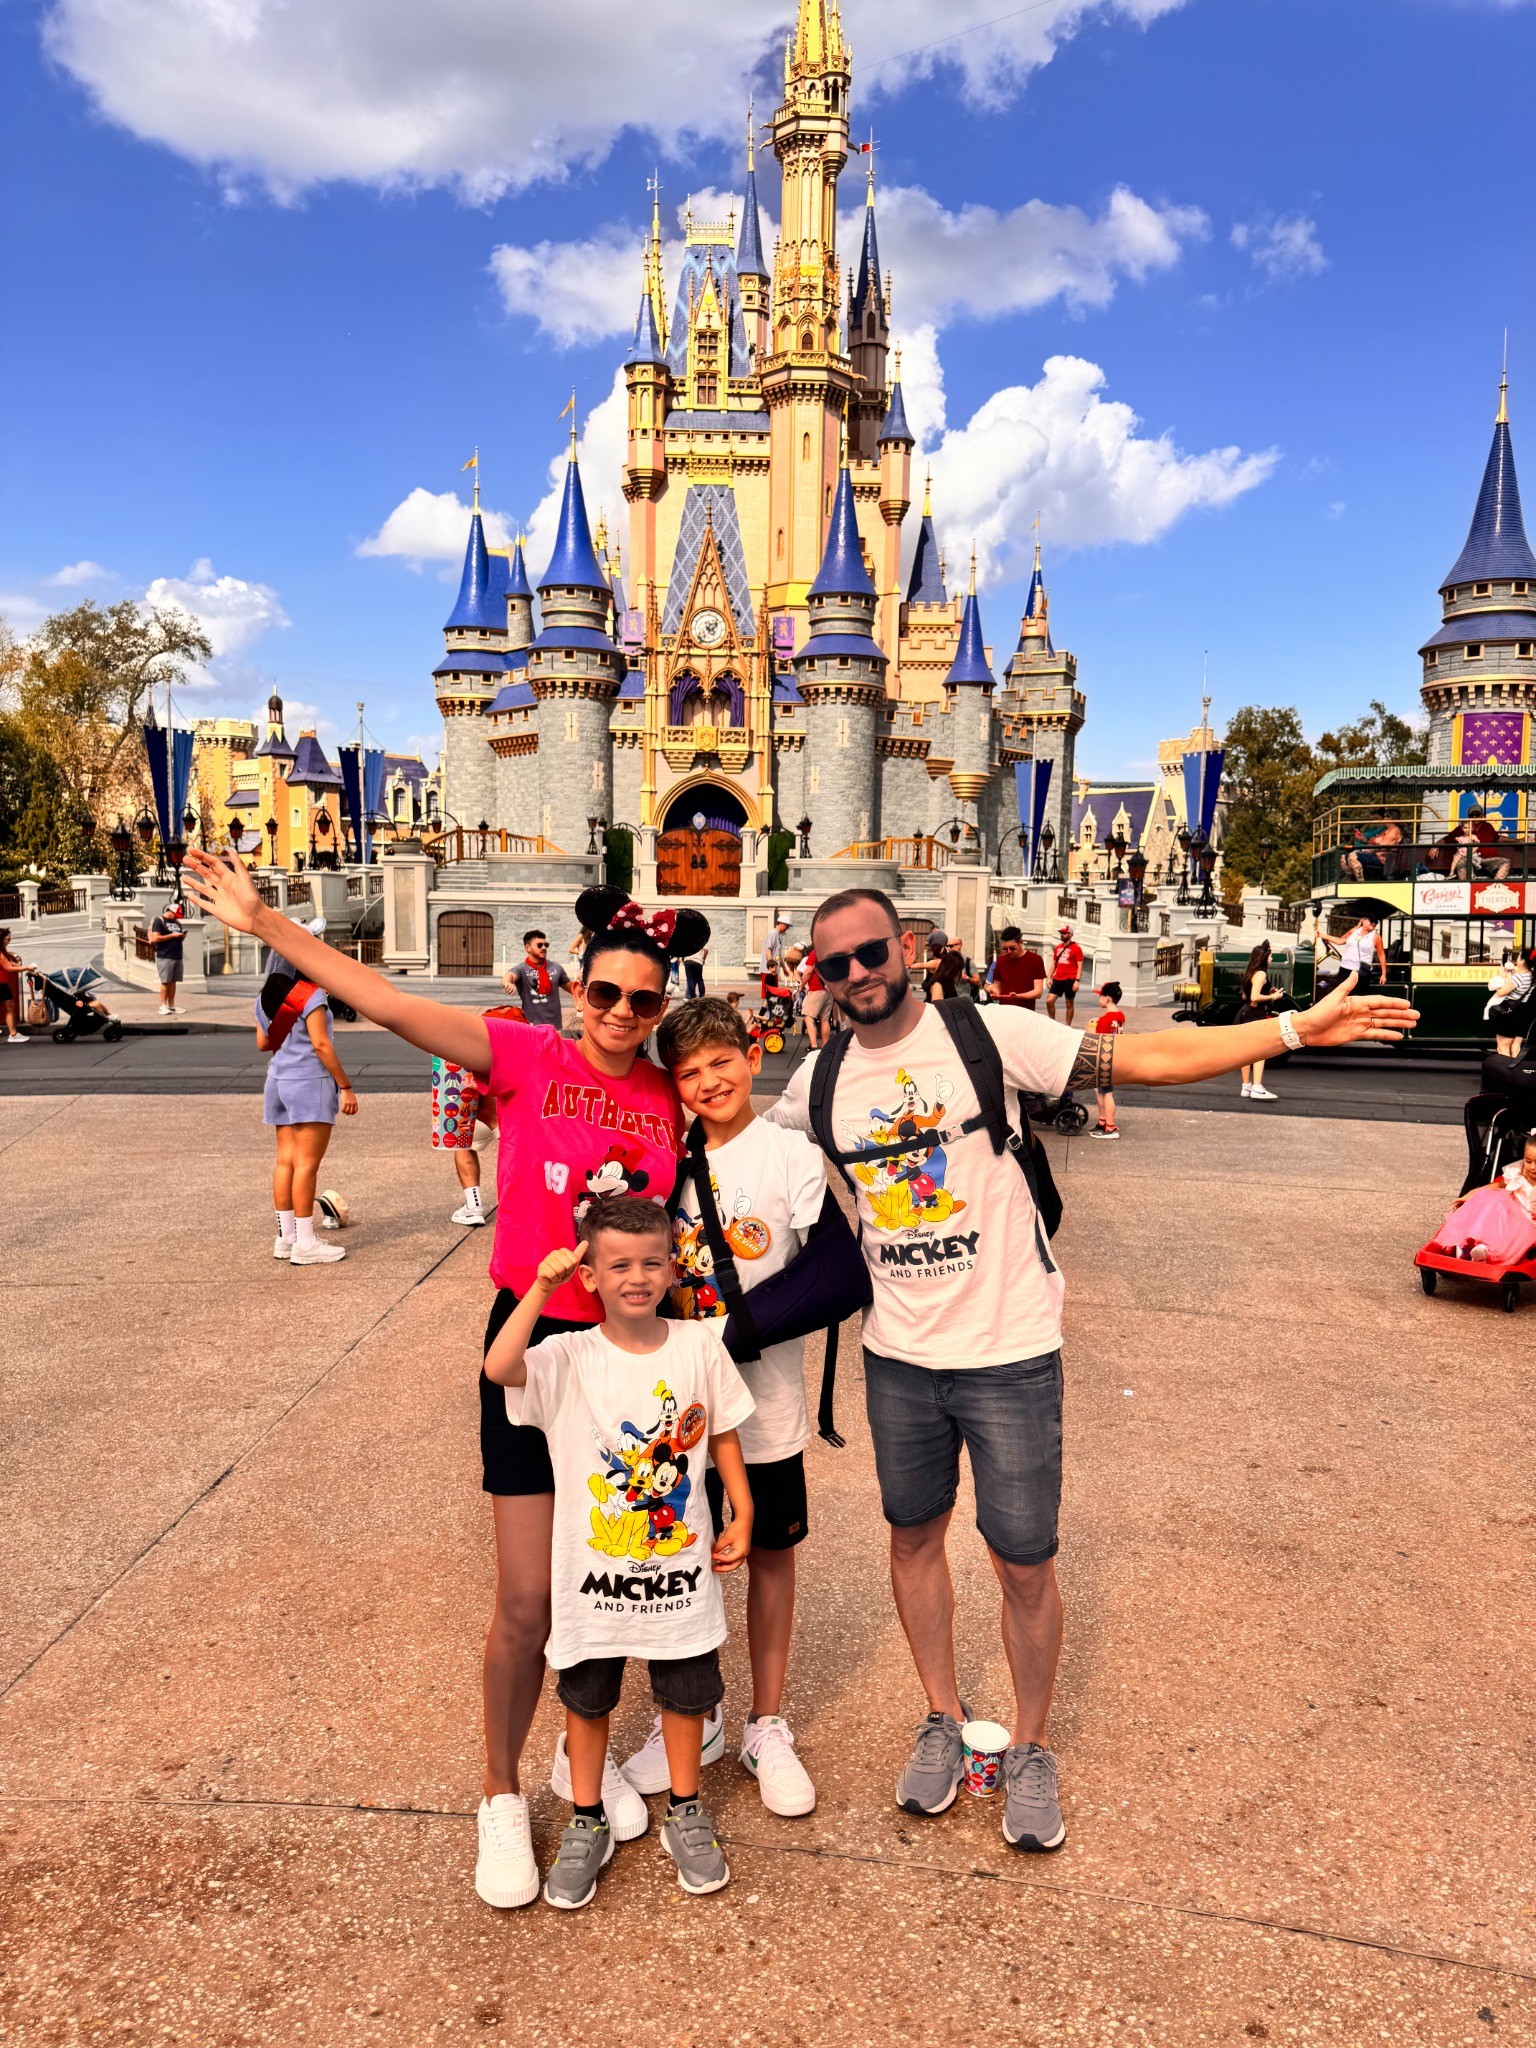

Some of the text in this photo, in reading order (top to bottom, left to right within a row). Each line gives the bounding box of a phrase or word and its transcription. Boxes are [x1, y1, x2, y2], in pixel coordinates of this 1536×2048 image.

[1420, 885, 1463, 905] Casey's
[1481, 896, 1514, 904] THEATER
[1433, 969, 1503, 979] MAIN STRE
[544, 1160, 570, 1195] 19
[880, 1230, 980, 1266] MICKEY
[890, 1260, 974, 1278] AND FRIENDS
[627, 1560, 662, 1575] Disney
[579, 1565, 703, 1602] MICKEY
[594, 1597, 692, 1614] AND FRIENDS
